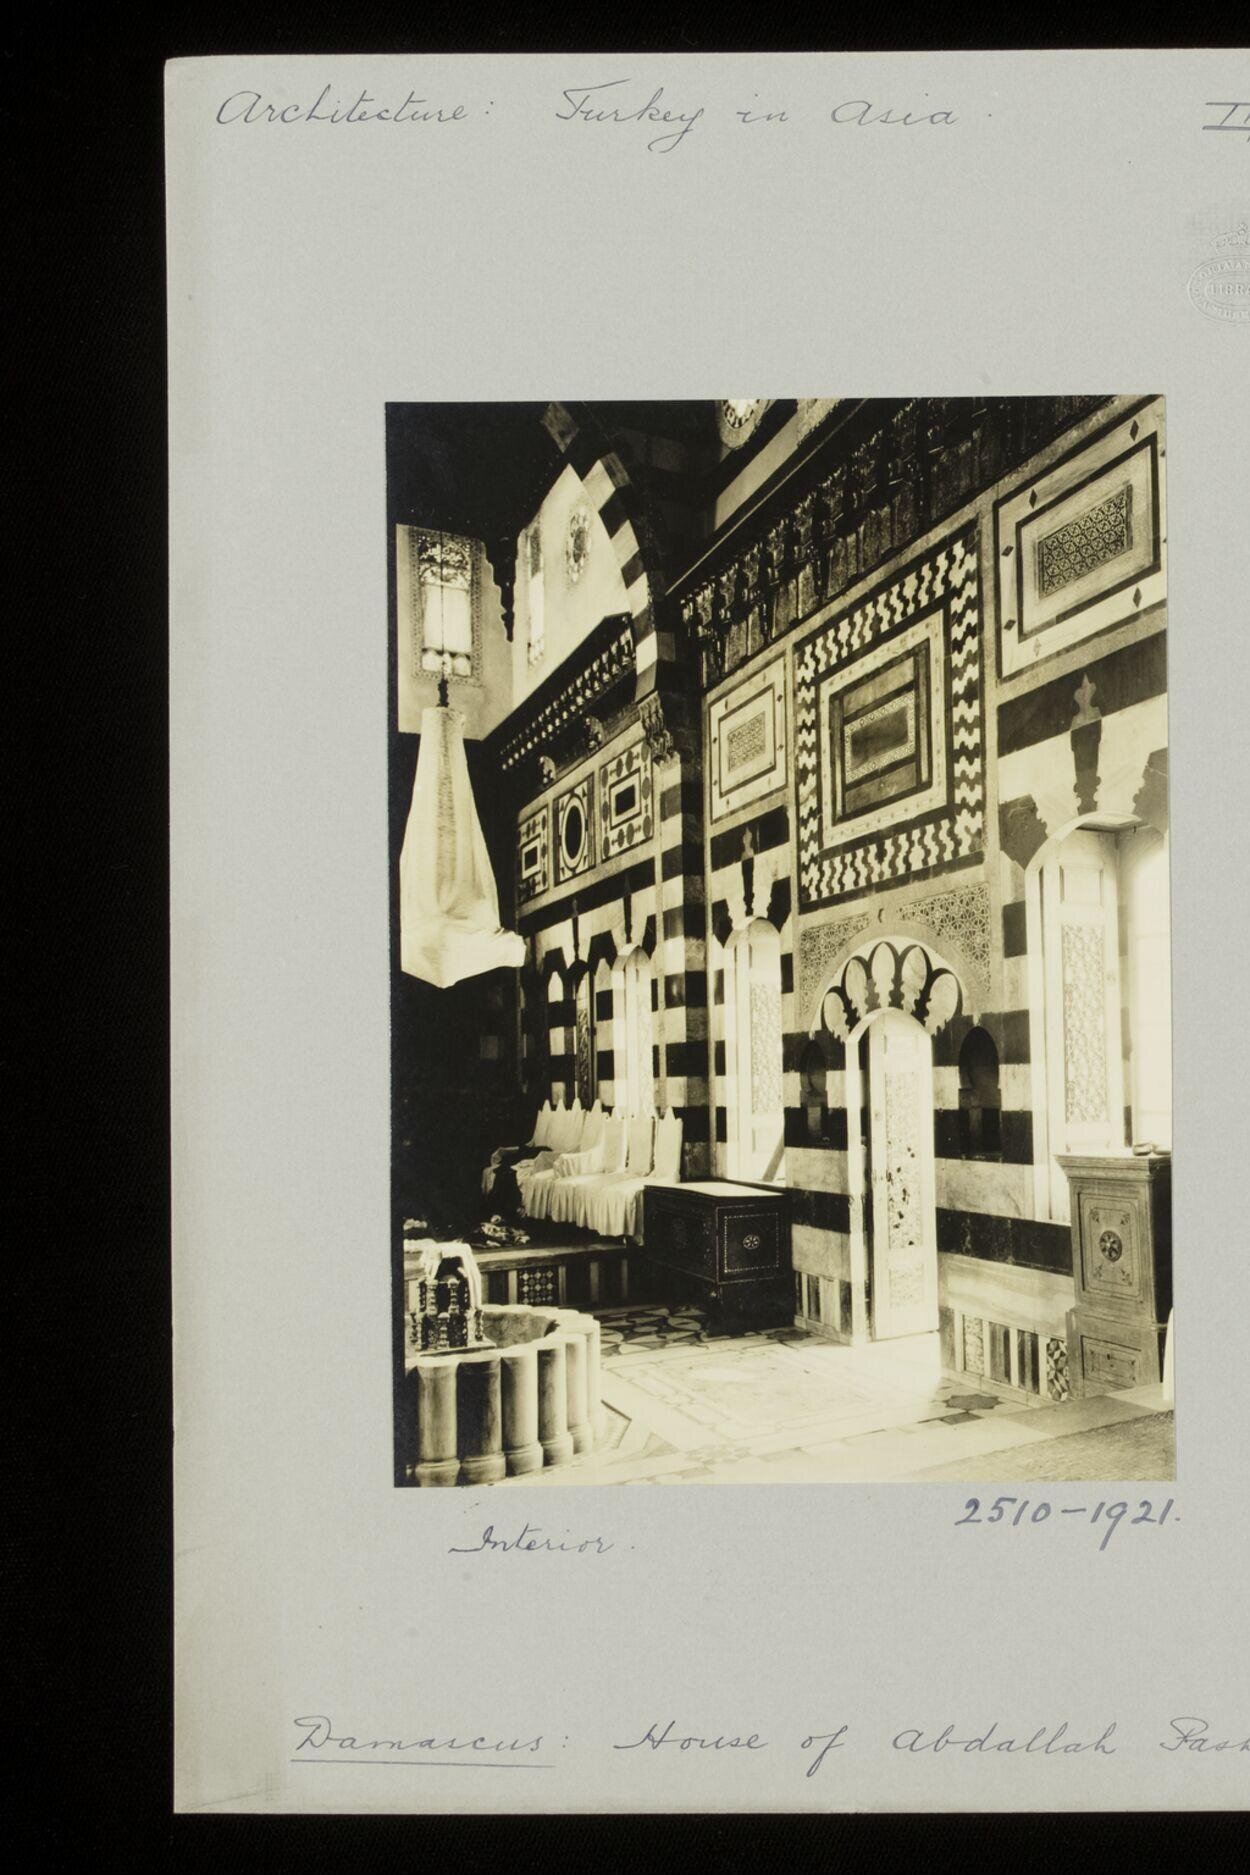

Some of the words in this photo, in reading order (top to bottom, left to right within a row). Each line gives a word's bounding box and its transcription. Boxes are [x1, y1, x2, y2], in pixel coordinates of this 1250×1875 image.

[215, 83, 495, 125] Architecture:
[555, 78, 705, 154] Turkey
[735, 93, 789, 124] in
[612, 1719, 769, 1751] House
[800, 1724, 849, 1778] of
[891, 1721, 1117, 1755] Abdallah
